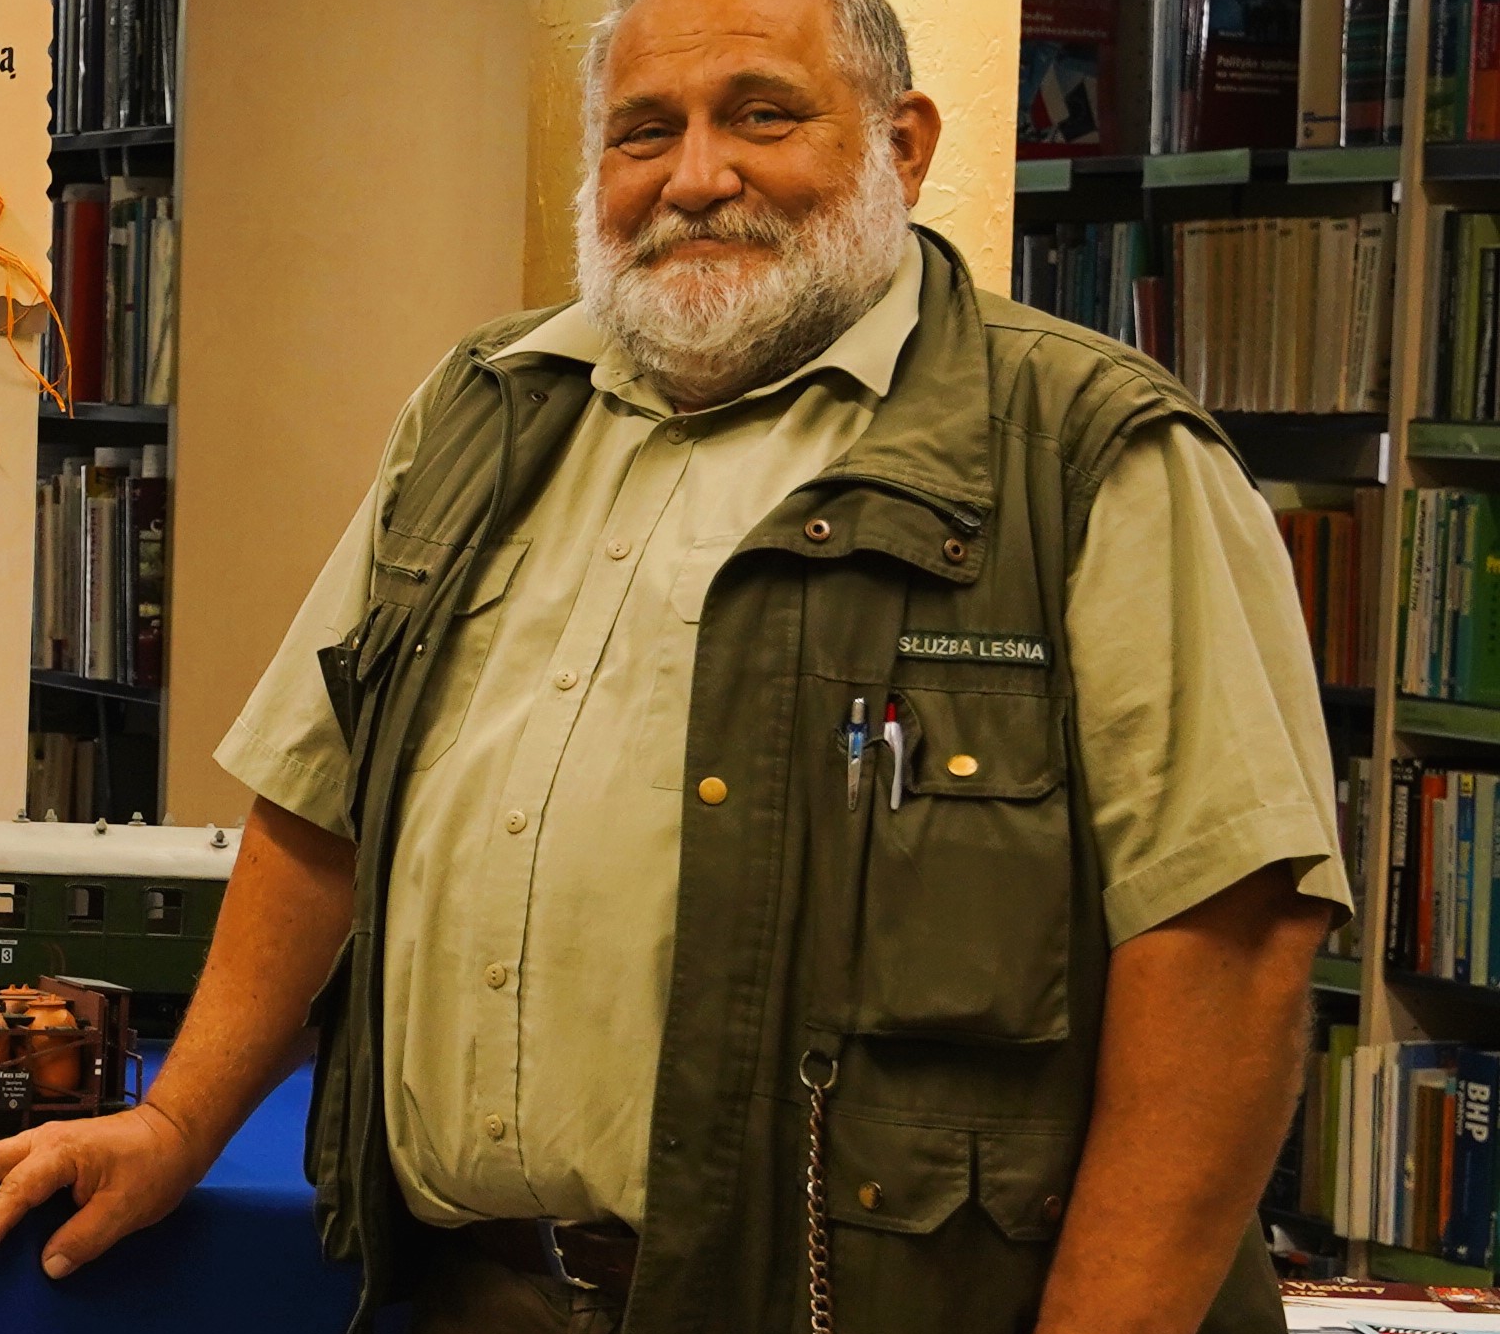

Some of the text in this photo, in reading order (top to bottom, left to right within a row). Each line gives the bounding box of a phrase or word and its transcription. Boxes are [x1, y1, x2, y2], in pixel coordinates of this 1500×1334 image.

[898, 635, 1044, 660] SŁUŻBA LEŚNA
[3, 949, 11, 962] 3
[1464, 1081, 1491, 1144] BHP
